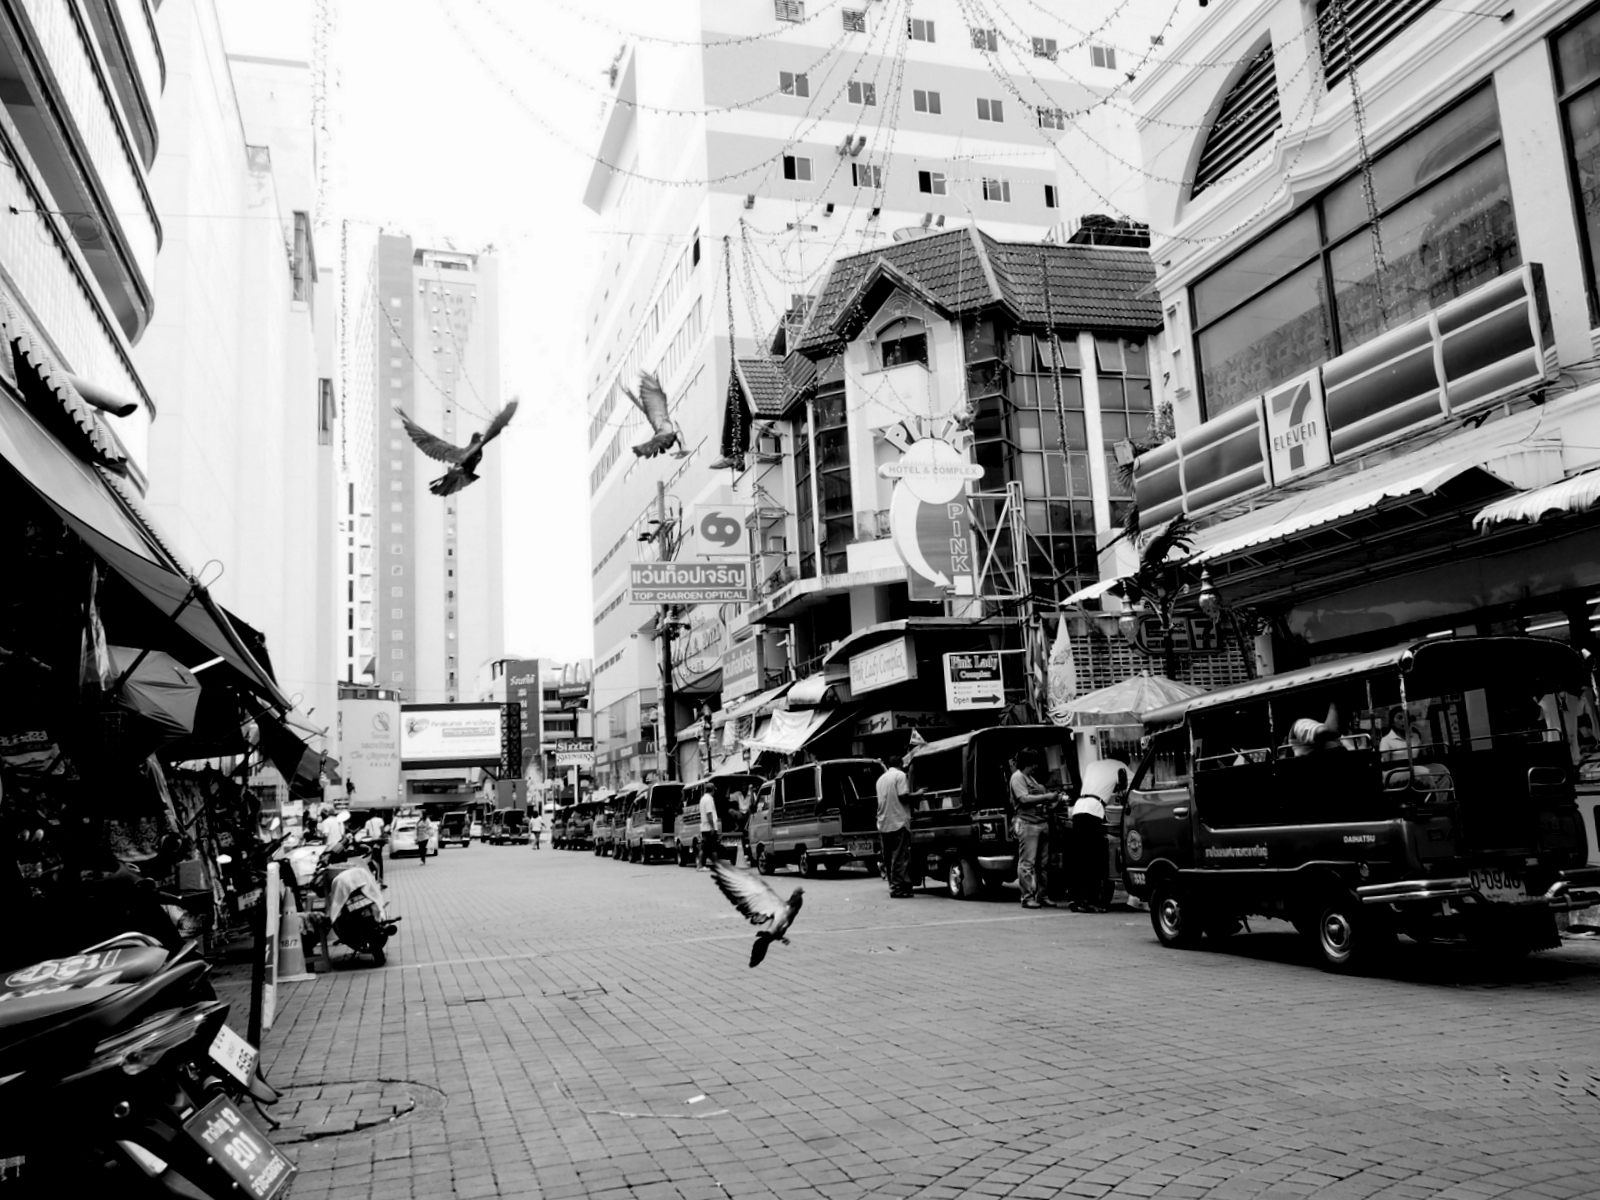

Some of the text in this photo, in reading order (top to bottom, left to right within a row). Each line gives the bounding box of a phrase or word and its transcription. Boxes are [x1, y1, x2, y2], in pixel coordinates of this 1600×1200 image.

[889, 466, 978, 476] HOTEL & COMPLEX
[946, 502, 971, 573] PINK
[632, 564, 745, 587] แว่นท็อปเจริญ
[634, 590, 746, 600] TOP CHAROEN OPTICAL
[950, 653, 998, 671] Pink Lady
[959, 670, 992, 680] Complex
[953, 696, 970, 706] Open
[1343, 834, 1376, 844] DAIHATSU
[280, 939, 298, 948] 18/7
[223, 1132, 263, 1170] 201
